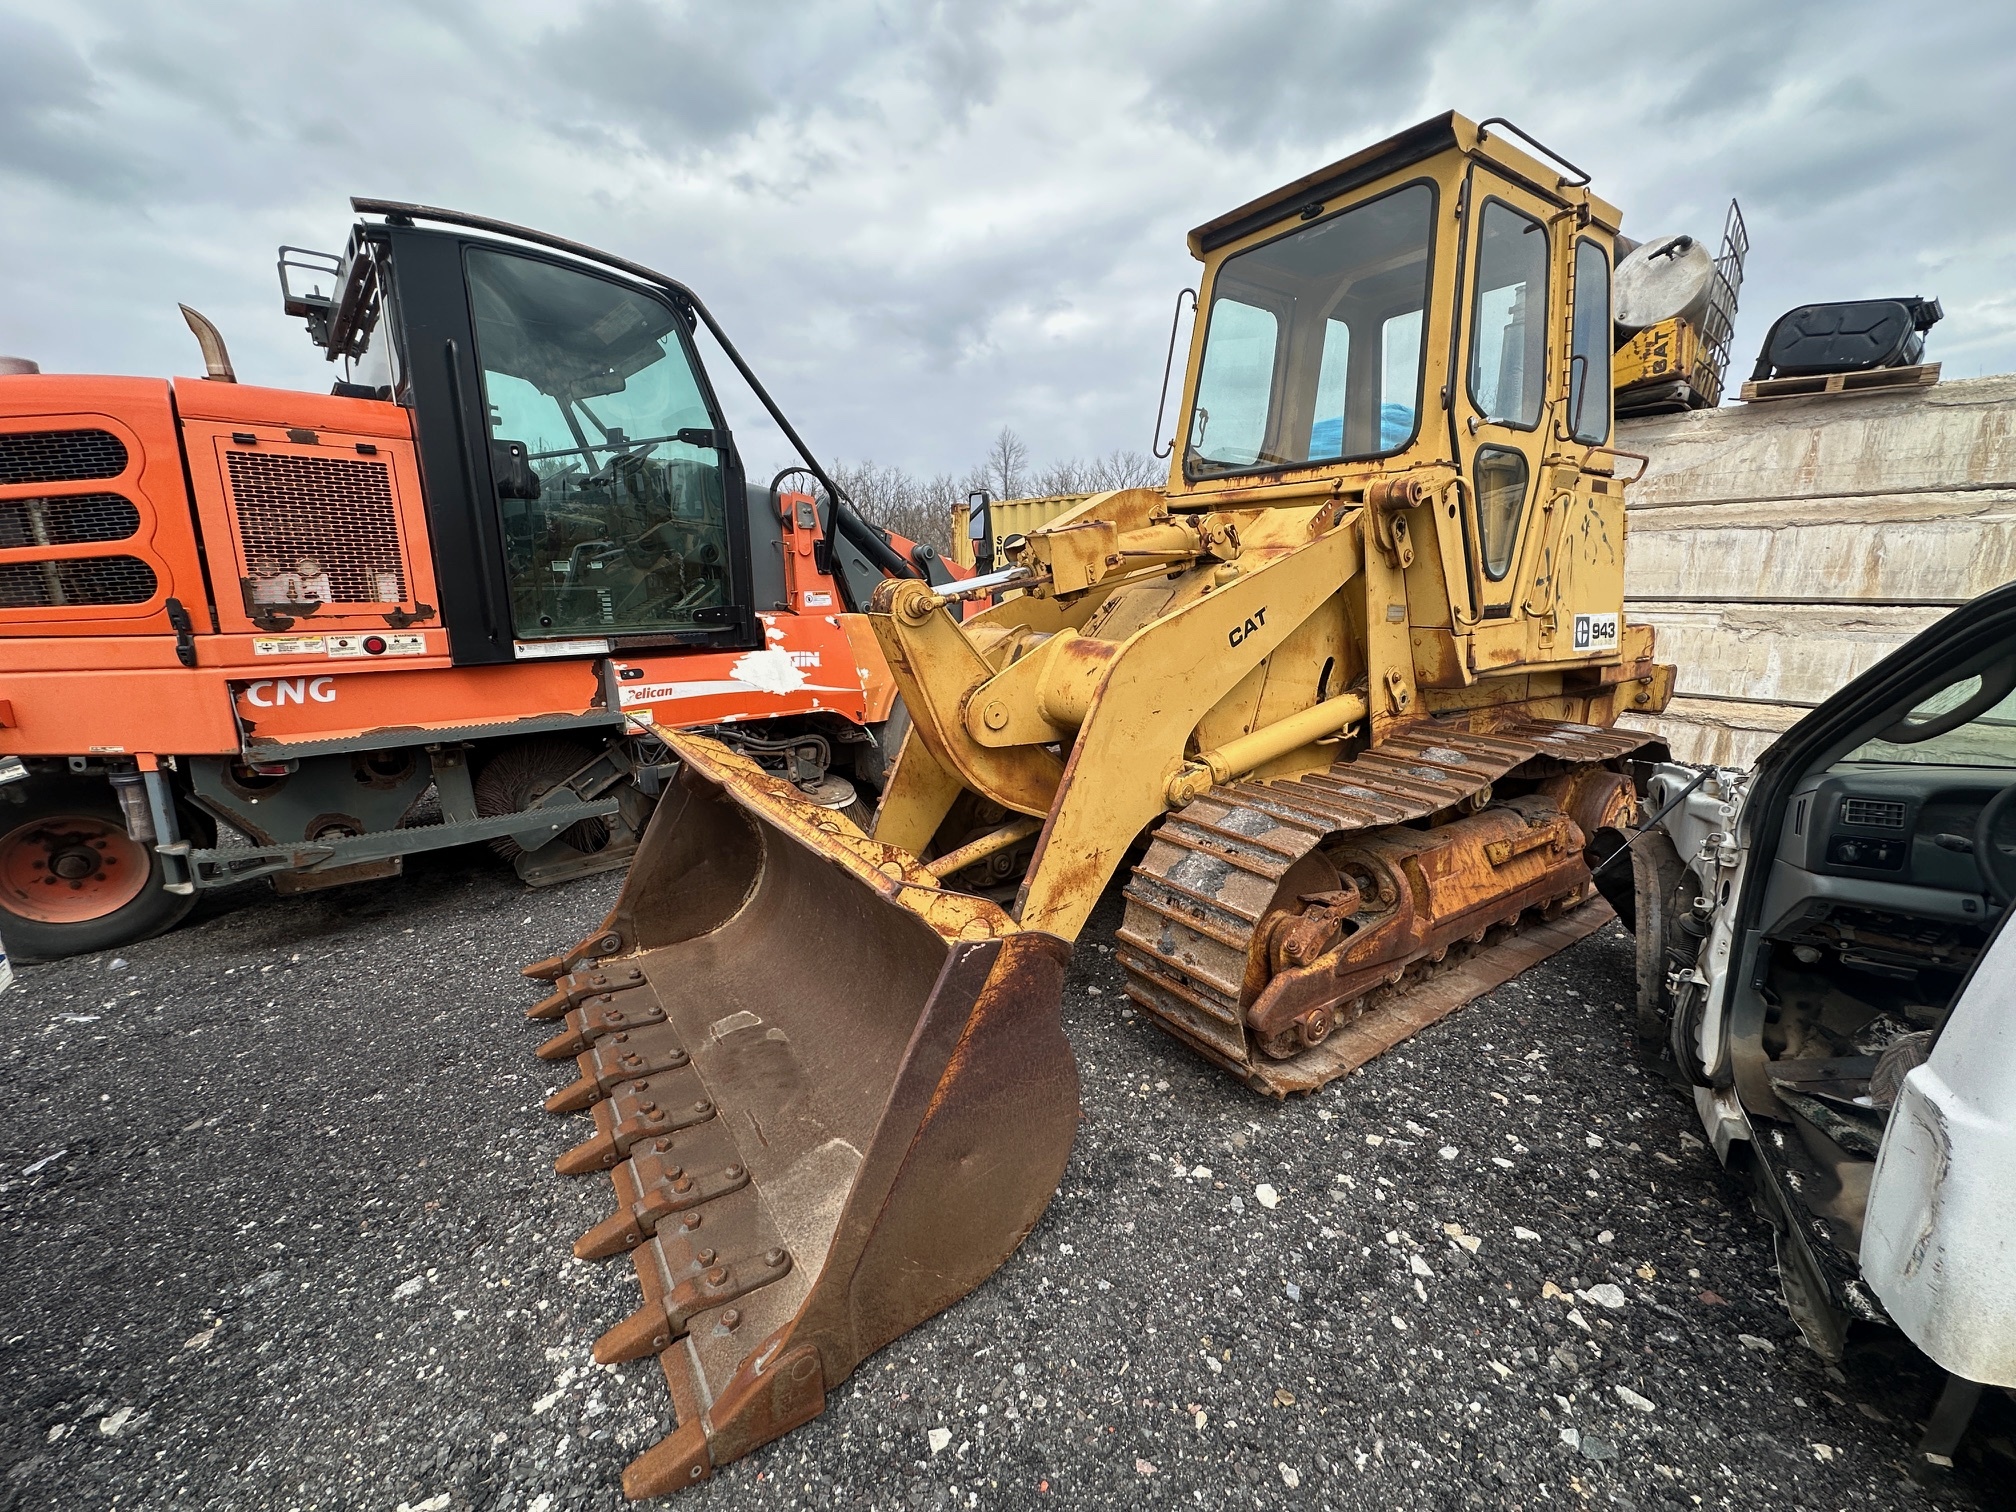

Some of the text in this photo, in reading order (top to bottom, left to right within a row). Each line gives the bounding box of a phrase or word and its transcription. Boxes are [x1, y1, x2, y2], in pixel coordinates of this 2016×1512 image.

[1228, 606, 1266, 648] CAT
[1592, 622, 1616, 639] 943
[246, 676, 337, 708] CNG
